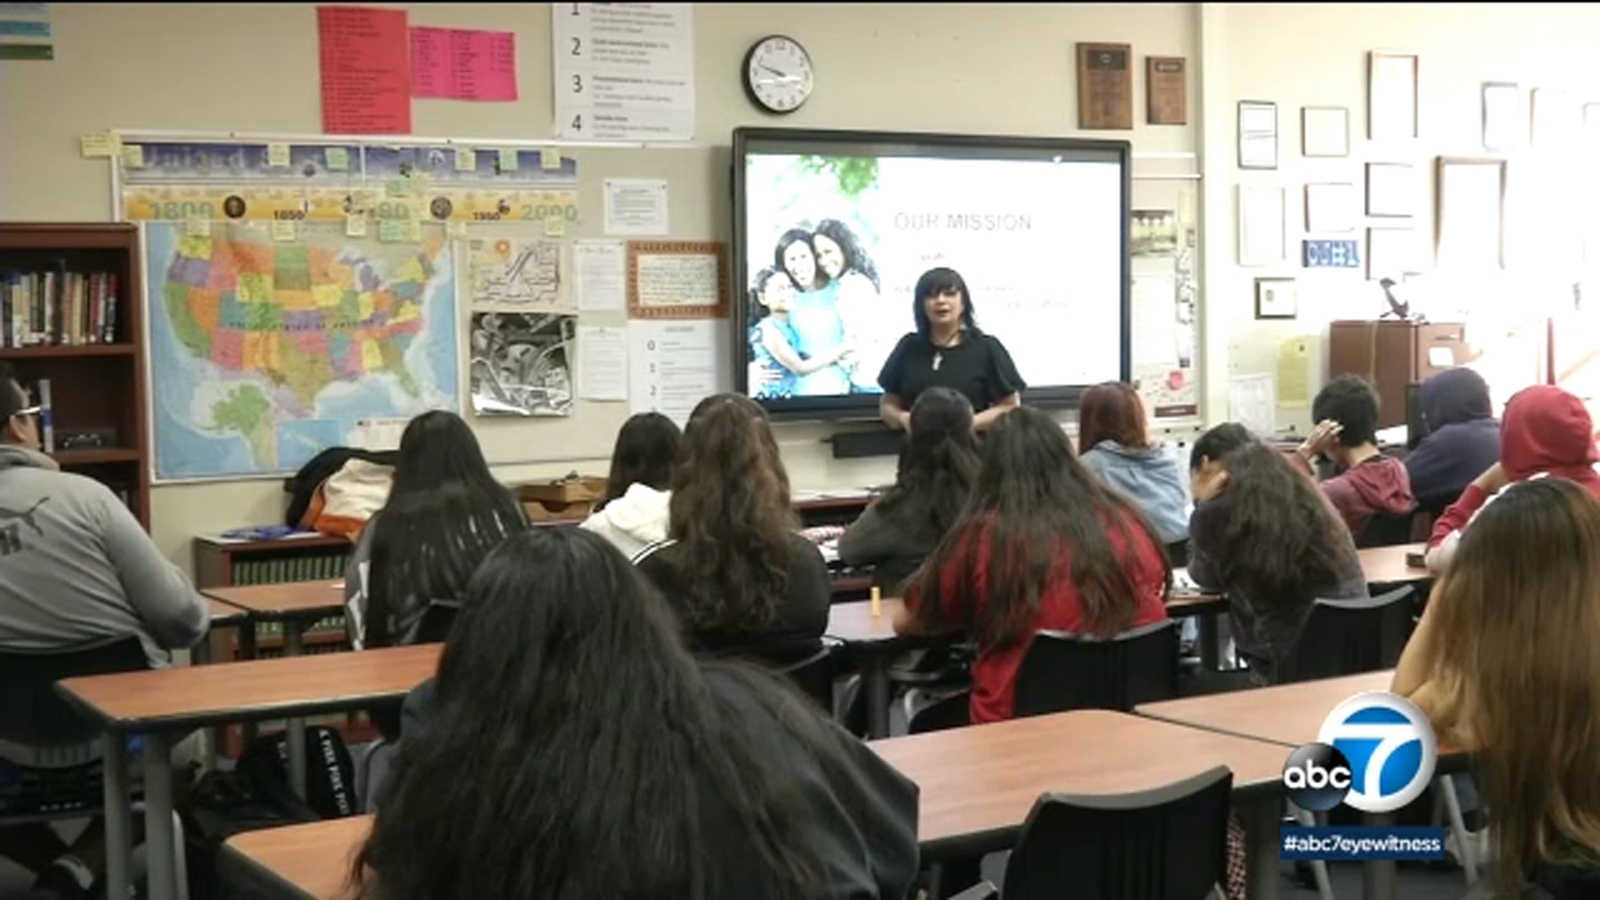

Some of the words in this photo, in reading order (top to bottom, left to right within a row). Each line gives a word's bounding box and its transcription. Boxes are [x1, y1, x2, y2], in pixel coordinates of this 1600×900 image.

[571, 37, 581, 55] 2
[573, 74, 583, 93] 3
[571, 114, 582, 131] 4
[894, 212, 939, 231] OUR
[947, 213, 1031, 231] MISSION
